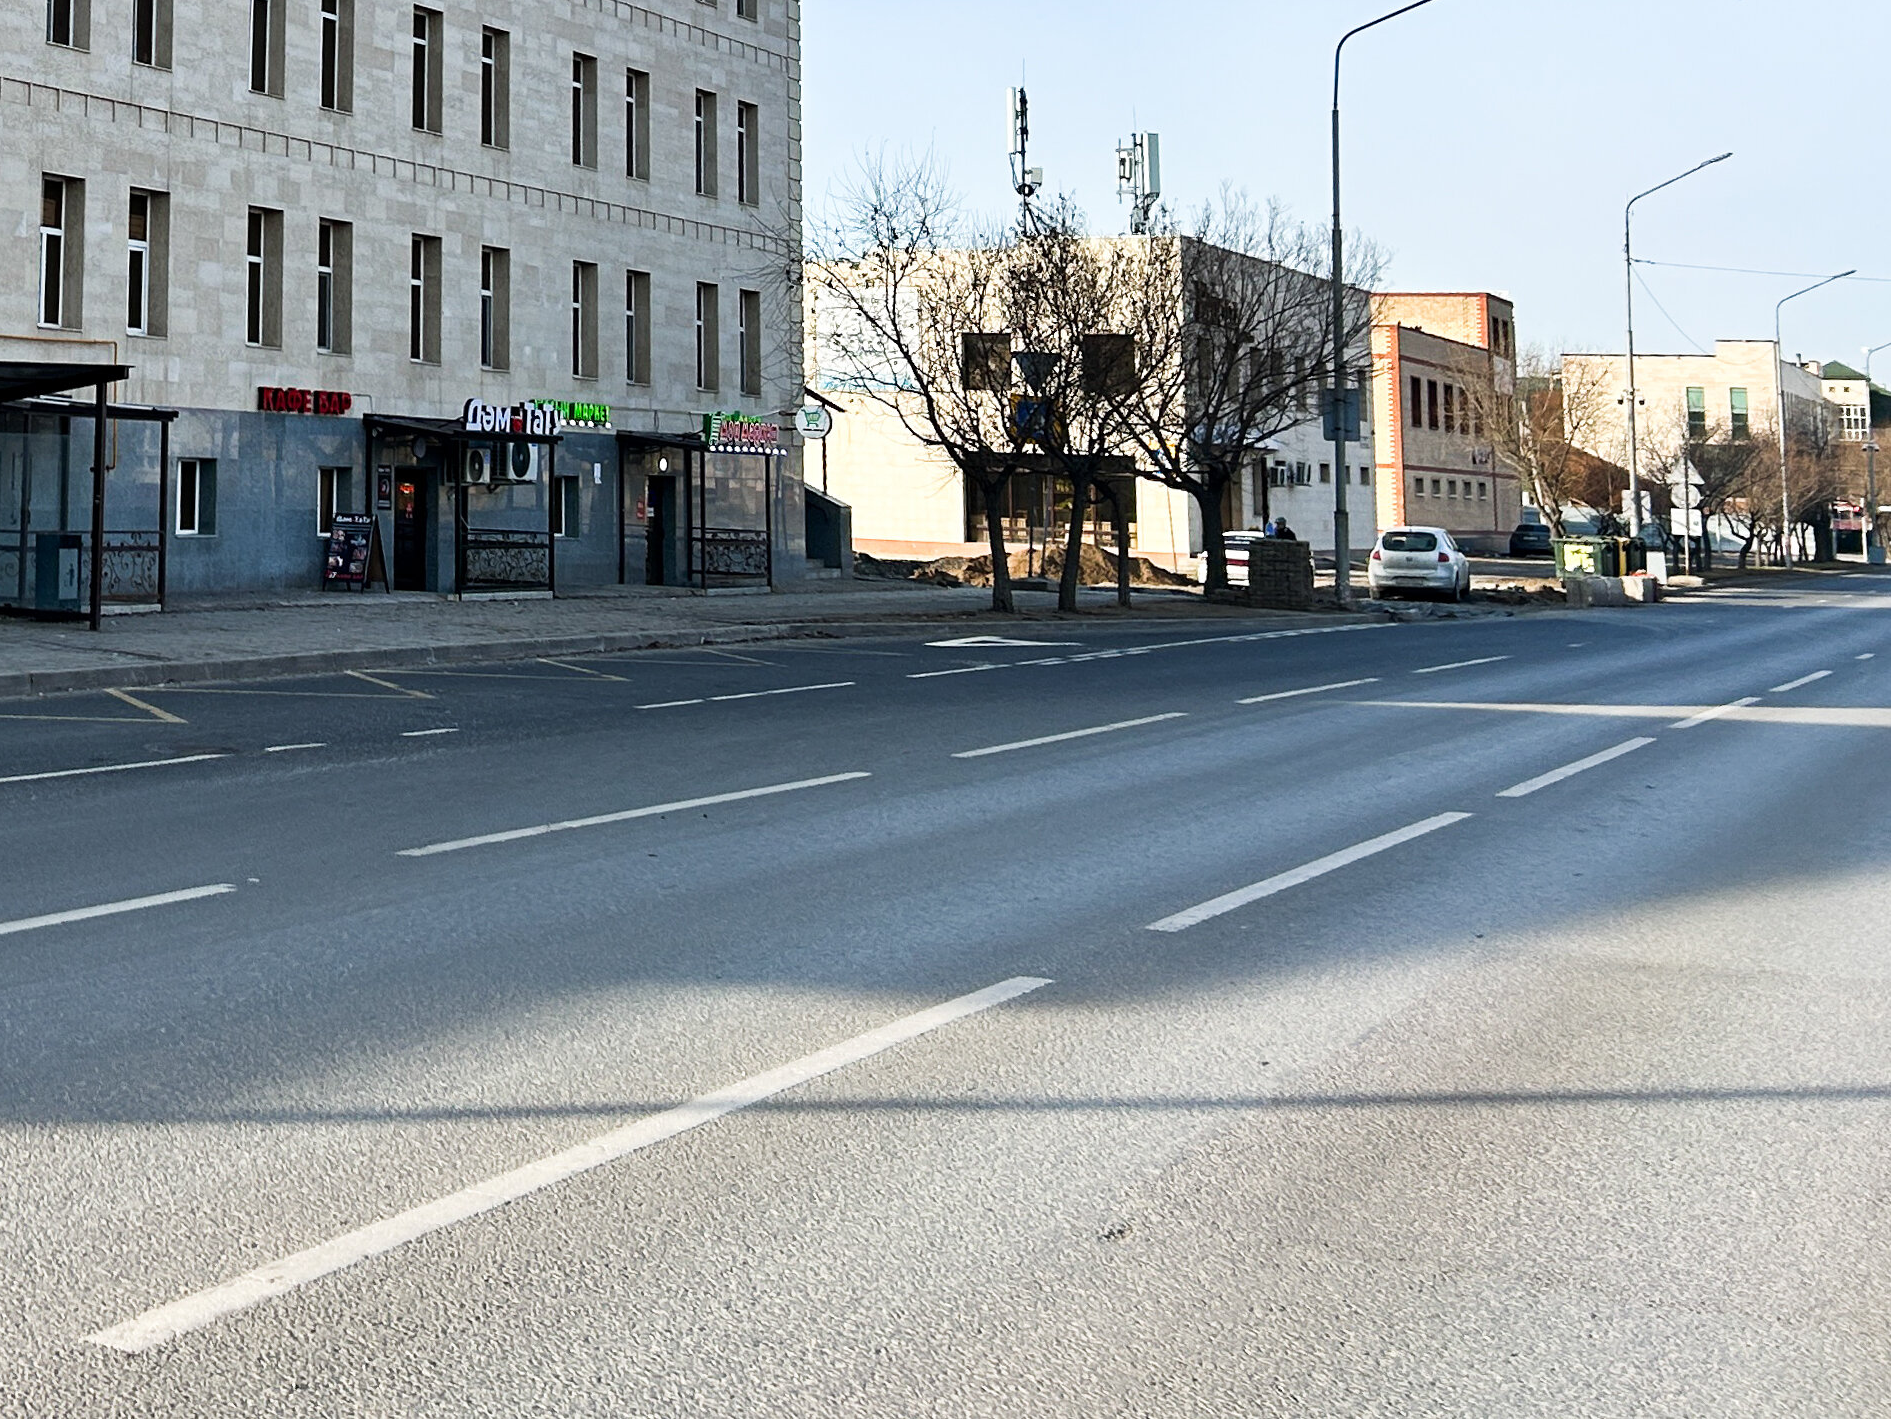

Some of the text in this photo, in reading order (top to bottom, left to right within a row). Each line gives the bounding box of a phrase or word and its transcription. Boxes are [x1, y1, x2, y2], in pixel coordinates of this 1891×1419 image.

[258, 387, 352, 414] КАФЕ БАР
[573, 402, 611, 423] МАРКЕТ
